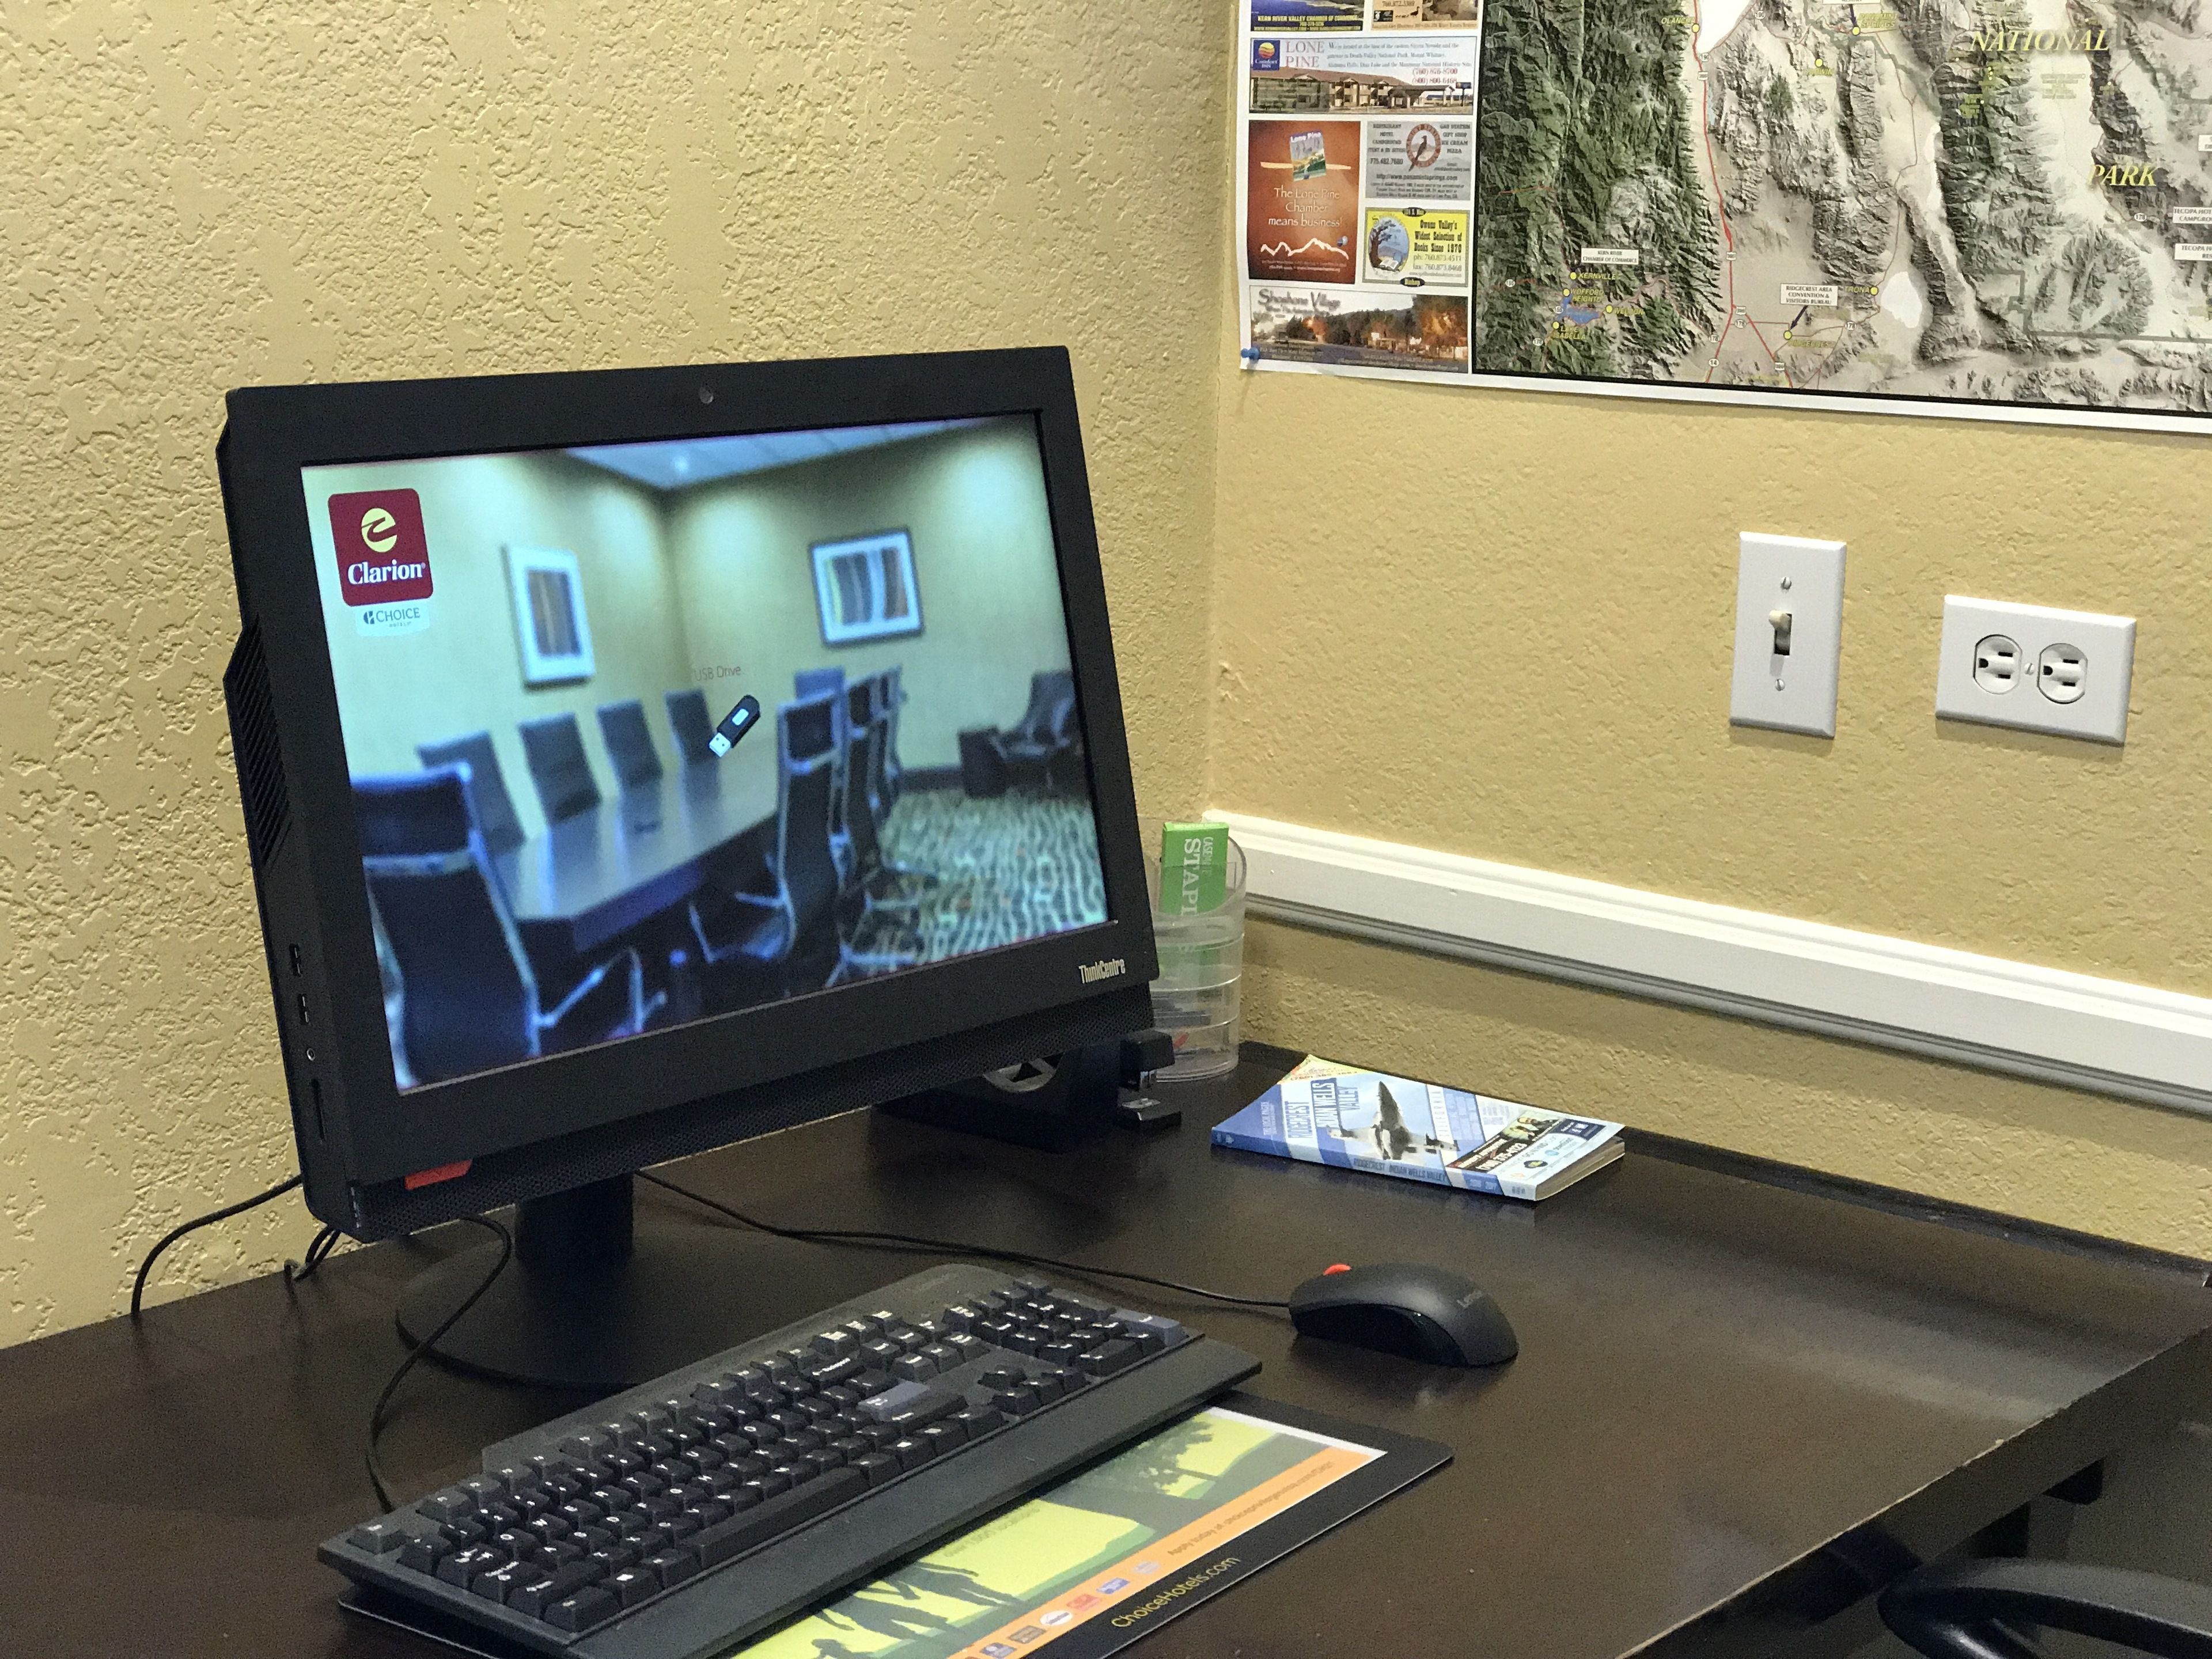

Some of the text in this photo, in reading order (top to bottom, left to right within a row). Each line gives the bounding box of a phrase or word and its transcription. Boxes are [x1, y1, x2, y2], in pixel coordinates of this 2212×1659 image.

[1286, 41, 1325, 54] LONE
[1970, 29, 2109, 52] NATIONAL
[1285, 56, 1320, 68] PINE
[2085, 164, 2157, 187] PARK
[1274, 184, 1340, 199] The Lone Pine
[1285, 199, 1328, 213] Chamber
[1268, 213, 1342, 227] means business!
[1420, 219, 1457, 232] Owens Valley's
[1447, 243, 1462, 253] 1970
[1578, 272, 1616, 281] KERNVILLE
[347, 558, 424, 585] Clarion
[376, 607, 421, 623] CHOICE
[694, 665, 742, 682] USB Drive
[1078, 958, 1126, 984] ThinkCentre
[1312, 1082, 1338, 1107] WELLS
[1337, 1085, 1361, 1111] VALLEY
[1284, 1101, 1313, 1139] RIDGECREST
[1431, 1090, 1450, 1138] CALIFORNIA
[1407, 1166, 1426, 1178] WELLS
[1111, 1556, 1242, 1628] ChoiceHotels.com
